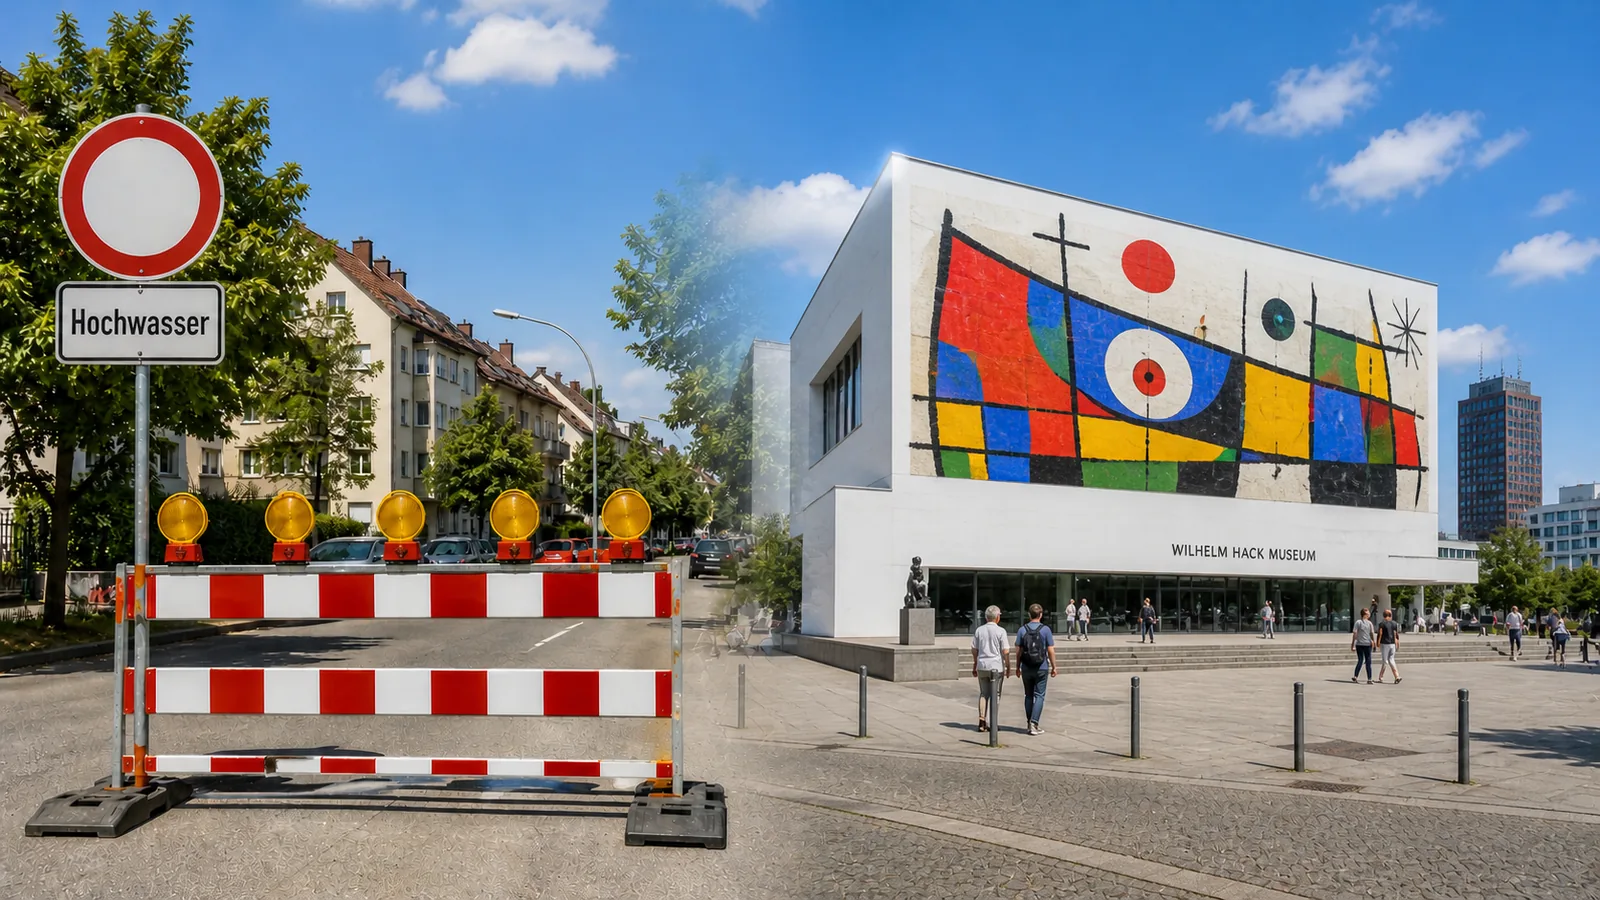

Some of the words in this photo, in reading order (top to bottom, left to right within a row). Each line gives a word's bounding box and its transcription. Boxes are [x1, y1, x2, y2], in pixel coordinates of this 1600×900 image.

[71, 308, 210, 336] Hochwasser
[1171, 543, 1228, 558] WILHELM
[1232, 547, 1265, 560] HACK
[1268, 548, 1316, 562] MUSEUM
